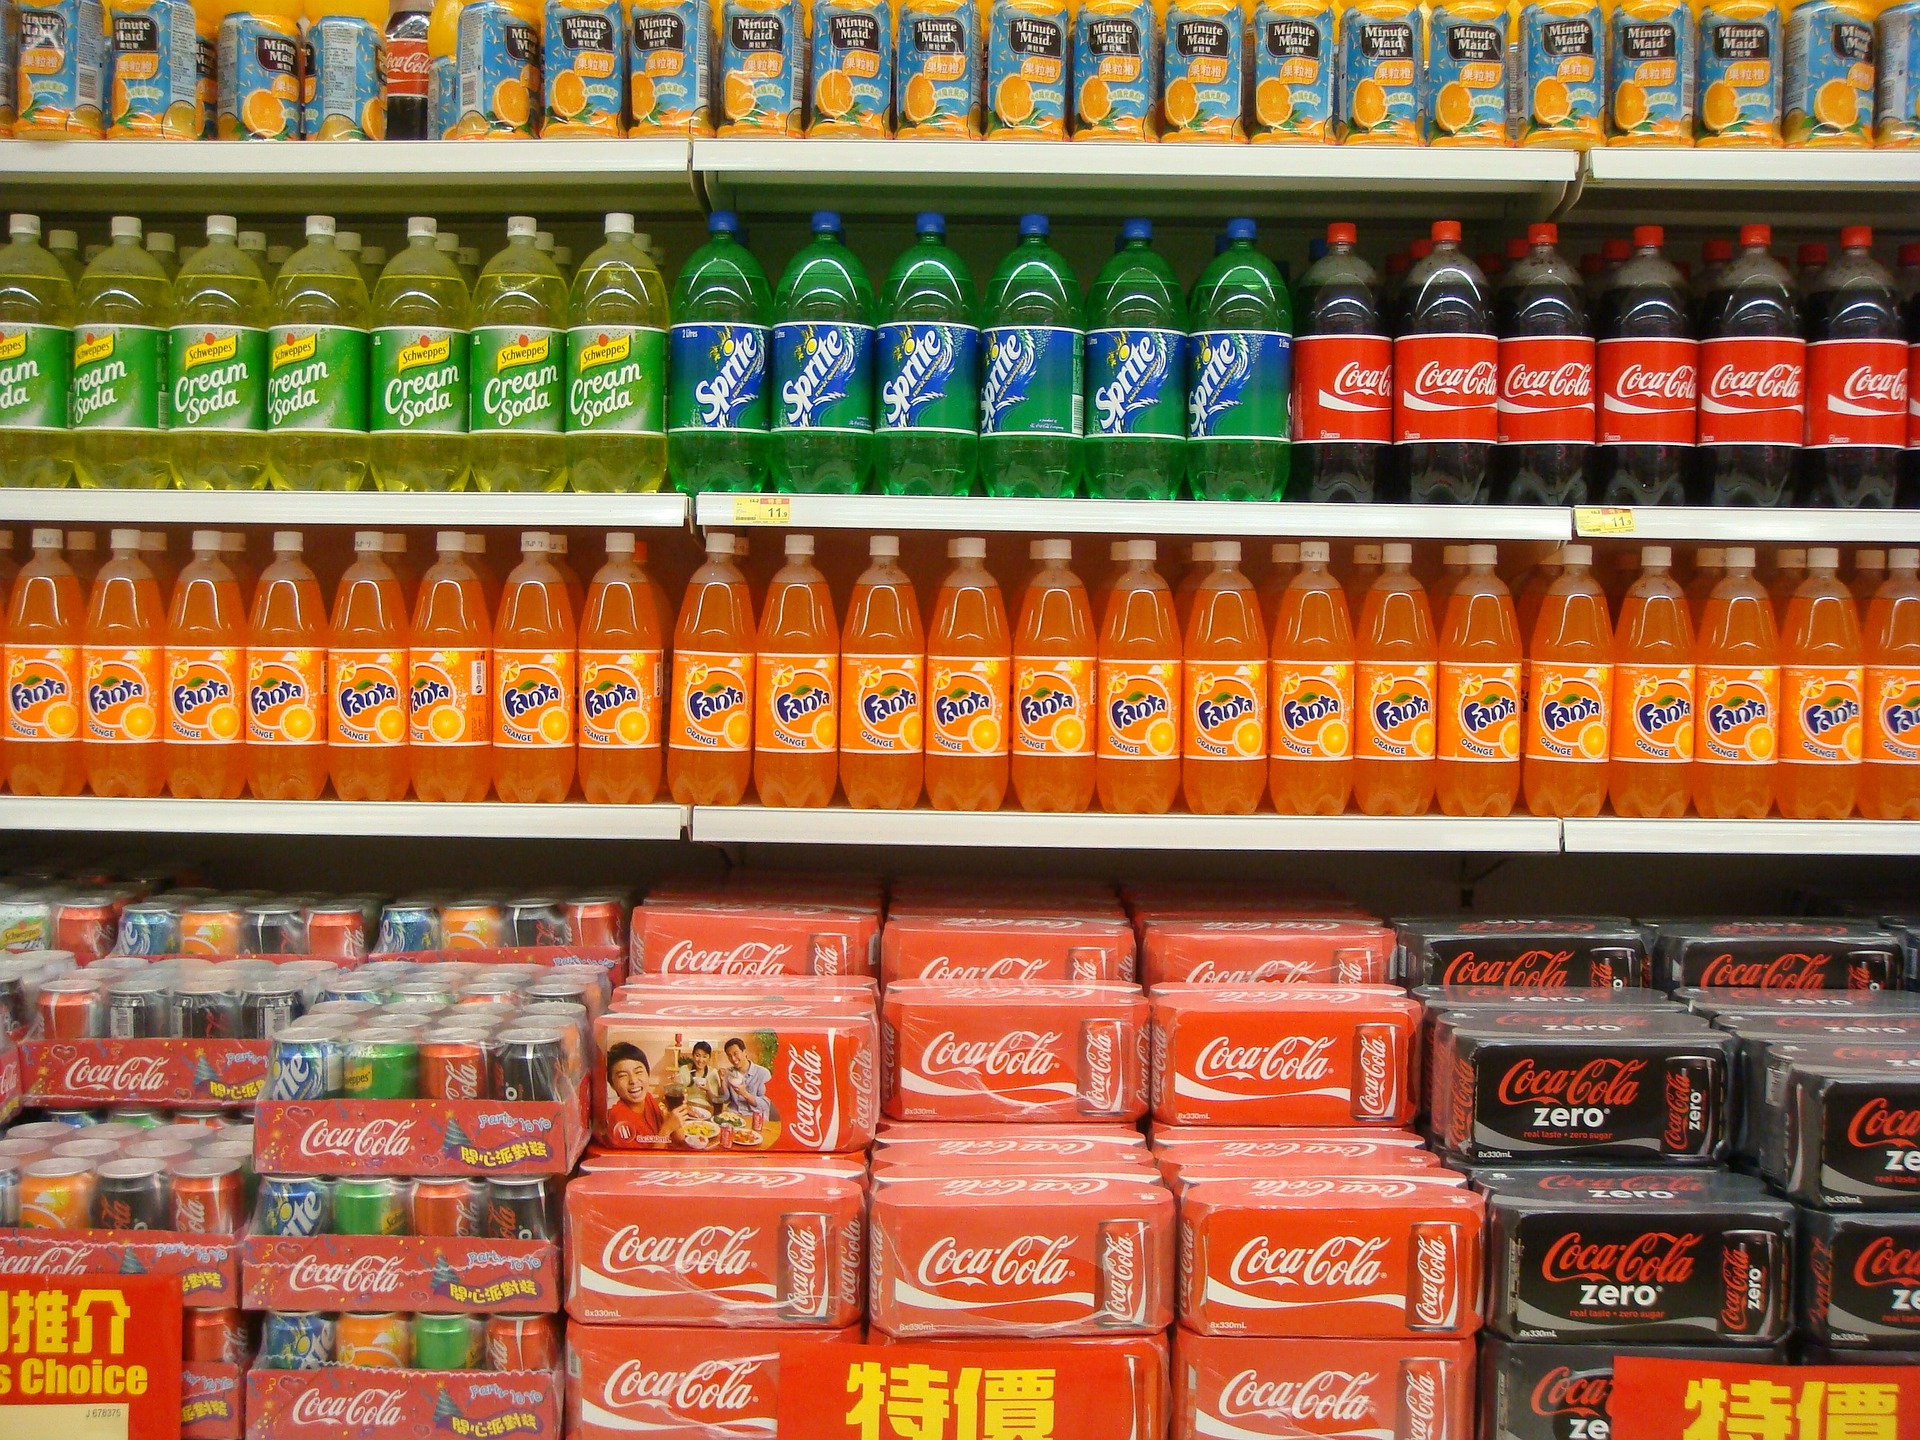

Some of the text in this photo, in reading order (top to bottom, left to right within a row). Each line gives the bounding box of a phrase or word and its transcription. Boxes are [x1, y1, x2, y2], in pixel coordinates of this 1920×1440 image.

[566, 18, 608, 31] Minute
[571, 29, 600, 40] Maid
[639, 17, 678, 30] Minute
[643, 28, 672, 39] Maid
[737, 18, 780, 31] Minute
[742, 30, 774, 40] Maid
[834, 18, 874, 31] Minute
[840, 29, 871, 40] Maid
[918, 22, 957, 32] Minute
[922, 32, 951, 42] Maid
[1015, 20, 1057, 35] Minute
[1020, 33, 1051, 45] Maid
[1092, 22, 1133, 35] Minute
[1097, 34, 1127, 45] Maid
[1182, 23, 1223, 35] Minute
[1187, 34, 1219, 46] Maid
[1273, 23, 1314, 36] Minute
[1278, 34, 1309, 46] Maid
[1365, 25, 1409, 38] Minute
[1454, 27, 1496, 40] Minute
[1628, 27, 1671, 39] Minute
[1718, 27, 1762, 39] Minute
[1370, 36, 1402, 47] Maid
[1459, 38, 1490, 50] Maid
[1633, 38, 1665, 50] Maid
[1724, 38, 1757, 50] Maid
[189, 342, 233, 361] Schweppes
[275, 342, 311, 362] Schweppes
[403, 345, 447, 364] Schweppes
[501, 344, 546, 363] Schweppes
[584, 344, 626, 364] Schweppes
[175, 362, 249, 412] Cream
[268, 361, 329, 414] Cream
[385, 365, 460, 414] Cream
[484, 365, 558, 414] Cream
[571, 363, 642, 414] Cream
[696, 328, 756, 424] Sprite
[783, 329, 844, 422] Sprite
[883, 328, 942, 423] Sprite
[1096, 335, 1156, 428] Sprite
[1504, 363, 1592, 398] Coca-Cola
[1616, 364, 1696, 398] Coca-Col
[1710, 364, 1801, 398] Coca-Cola
[187, 389, 240, 424] Soda
[273, 387, 319, 425] Soda
[400, 390, 453, 426] Soda
[498, 390, 551, 426] Soda
[581, 387, 633, 427] Soda
[11, 679, 65, 712] Fanta
[90, 680, 142, 714] Fanta
[174, 680, 228, 714] Fanta
[250, 681, 302, 715] Fanta
[340, 681, 394, 717] Fanta
[505, 682, 558, 718] Fanta
[586, 683, 636, 718] Fanta
[690, 687, 743, 720] Fanta
[776, 689, 830, 722] Fanta
[864, 689, 916, 724] Fanta
[936, 691, 990, 726] Fanta
[1020, 691, 1073, 726] Fanta
[1112, 695, 1166, 729] Fanta
[10, 720, 36, 736] ORANGE
[172, 722, 200, 738] ORANGE
[1198, 696, 1252, 730] Fanta
[1284, 696, 1338, 730] Fanta
[1376, 696, 1428, 730] Fanta
[1465, 697, 1516, 732] Fanta
[1544, 698, 1599, 732] Fanta
[1640, 698, 1690, 733] Fanta
[1710, 700, 1766, 734] Fanta
[1807, 700, 1858, 734] Fanta
[338, 725, 368, 742] ORANGE
[503, 725, 532, 742] ORANGE
[686, 728, 717, 745] ORANGE
[774, 730, 806, 747] ORANGE
[862, 731, 894, 748] ORANGE
[1110, 737, 1139, 754] ORANGE
[1196, 738, 1226, 754] ORANGE
[1282, 738, 1311, 754] ORANGE
[1374, 738, 1406, 754] ORANGE
[1462, 739, 1494, 756] ORANGE
[1541, 738, 1572, 756] ORANGE
[1636, 740, 1669, 757] ORANGE
[1707, 741, 1738, 758] ORANGE
[921, 1031, 1062, 1076] Coca-Cola
[1086, 1029, 1110, 1110] Coca-Cola
[1195, 1036, 1337, 1081] Coca-Cola
[66, 1056, 170, 1090] Coca-Cola
[1359, 1035, 1386, 1115] Coca-Cola
[1498, 1058, 1648, 1106] Coca-Cola
[788, 1044, 822, 1147] Coca-Cola
[1689, 1093, 1702, 1131] zero
[1533, 1108, 1605, 1128] zero
[300, 1119, 416, 1156] Coca-Cola
[602, 1225, 760, 1275] Coca-Cola
[918, 1236, 1080, 1287] Coca-Cola
[1230, 1236, 1391, 1286] Coca-Cola
[1542, 1232, 1703, 1283] Coca-Cola
[290, 1254, 405, 1292] Coca-Cola
[788, 1225, 816, 1314] Coca-Cola
[1106, 1233, 1134, 1321] Coca-Cola
[1416, 1235, 1446, 1324] Coca-Cola
[1580, 1284, 1657, 1306] zero
[1747, 1268, 1762, 1310] zero
[1210, 1322, 1247, 1330] 8x330mL
[1618, 1310, 1637, 1318] zero
[20, 1358, 148, 1395] Choice
[604, 1359, 761, 1410] Coca-Cola
[292, 1388, 407, 1426] Coca-Cola
[846, 1361, 1056, 1440] 特價
[1219, 1369, 1379, 1421] Coca-Cola
[1682, 1378, 1900, 1440] 特價
[92, 1408, 121, 1418] 678375
